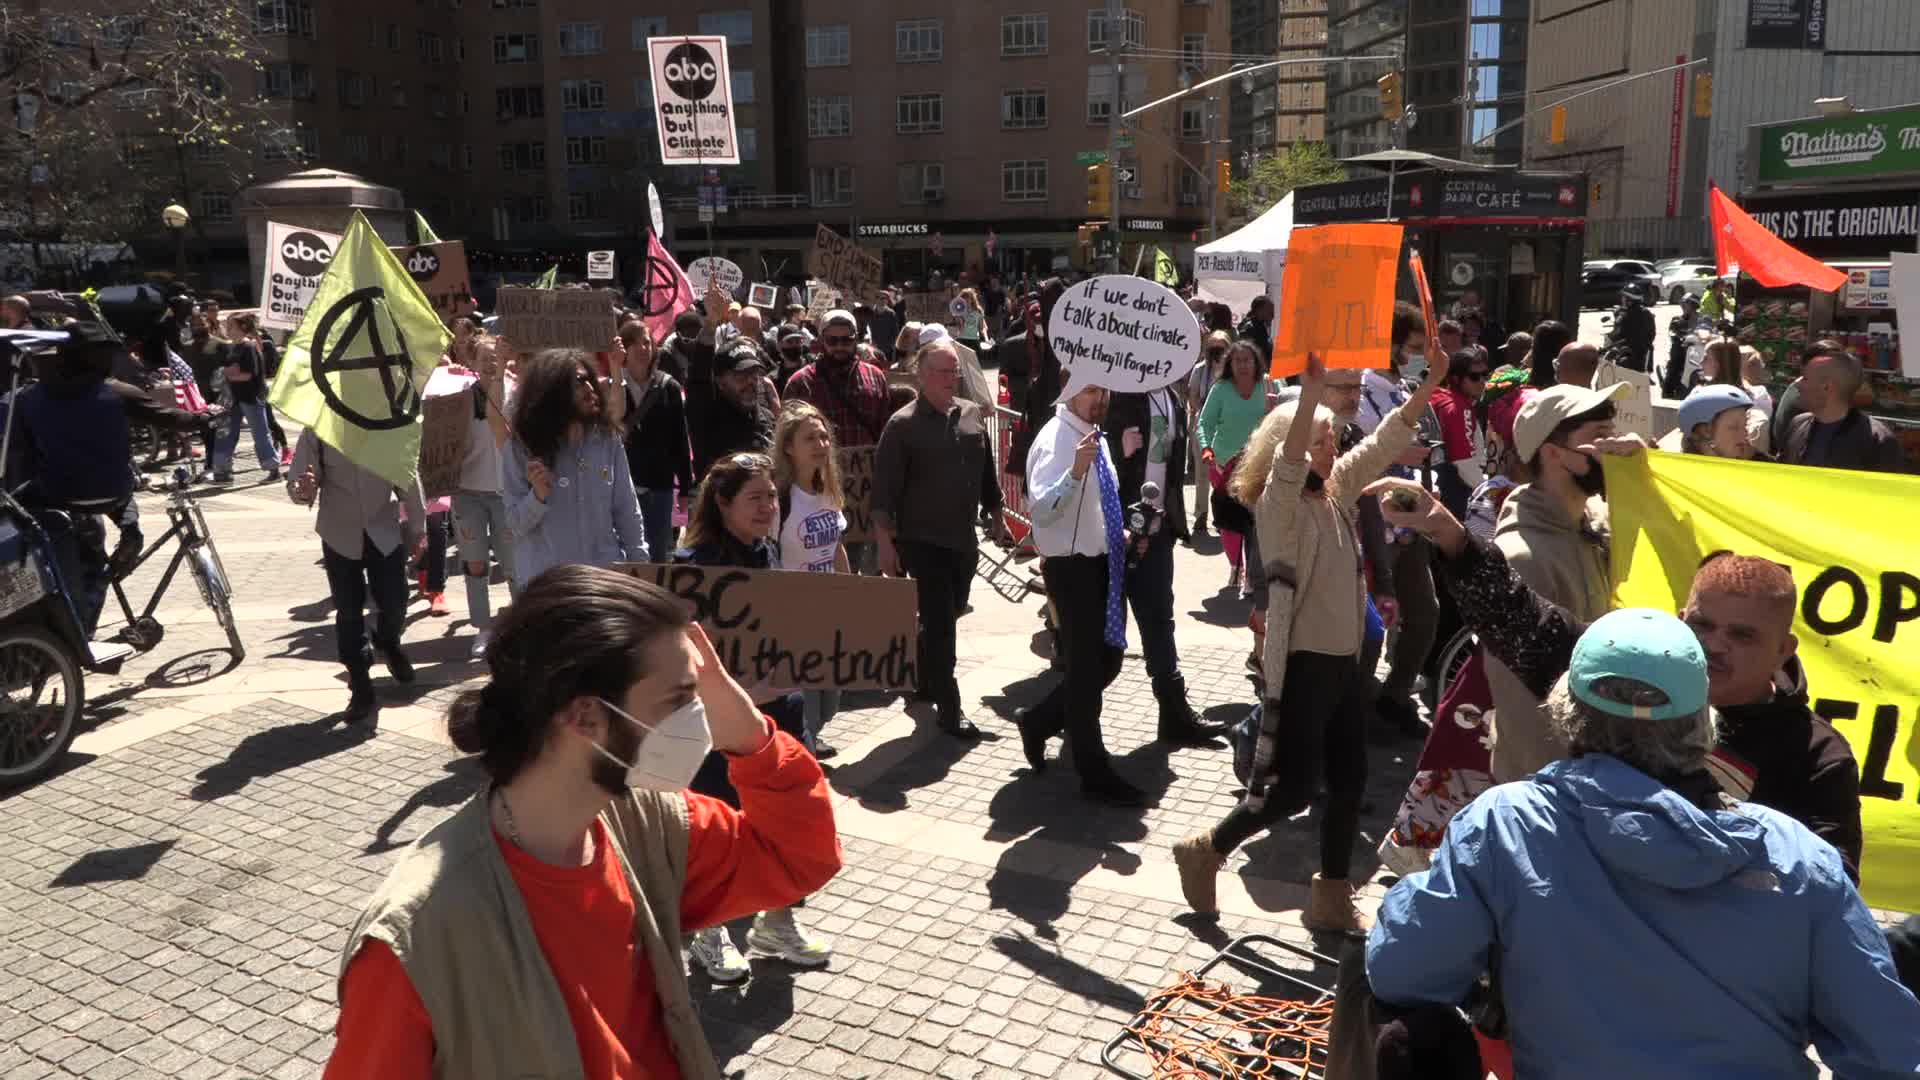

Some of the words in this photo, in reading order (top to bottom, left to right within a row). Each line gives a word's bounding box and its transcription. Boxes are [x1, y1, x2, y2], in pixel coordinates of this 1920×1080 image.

[665, 57, 717, 81] abc
[664, 117, 694, 133] but
[1781, 124, 1887, 157] Nathan's
[1476, 189, 1520, 208] CAFÉ
[859, 224, 928, 235] STARBUCKS
[1132, 220, 1163, 230] STARBUCKS
[1783, 211, 1799, 239] IS
[1803, 209, 1835, 238] THE
[1838, 205, 1918, 236] ORIGINAL
[282, 240, 332, 264] abc
[408, 252, 438, 273] abc
[271, 285, 299, 300] but
[1083, 279, 1099, 298] if
[1104, 289, 1128, 306] we
[1132, 292, 1169, 316] don't
[1063, 301, 1096, 329] talk
[1097, 312, 1142, 340] about
[1143, 323, 1189, 350] climate,
[1053, 336, 1090, 364] maybe
[751, 637, 825, 685] the
